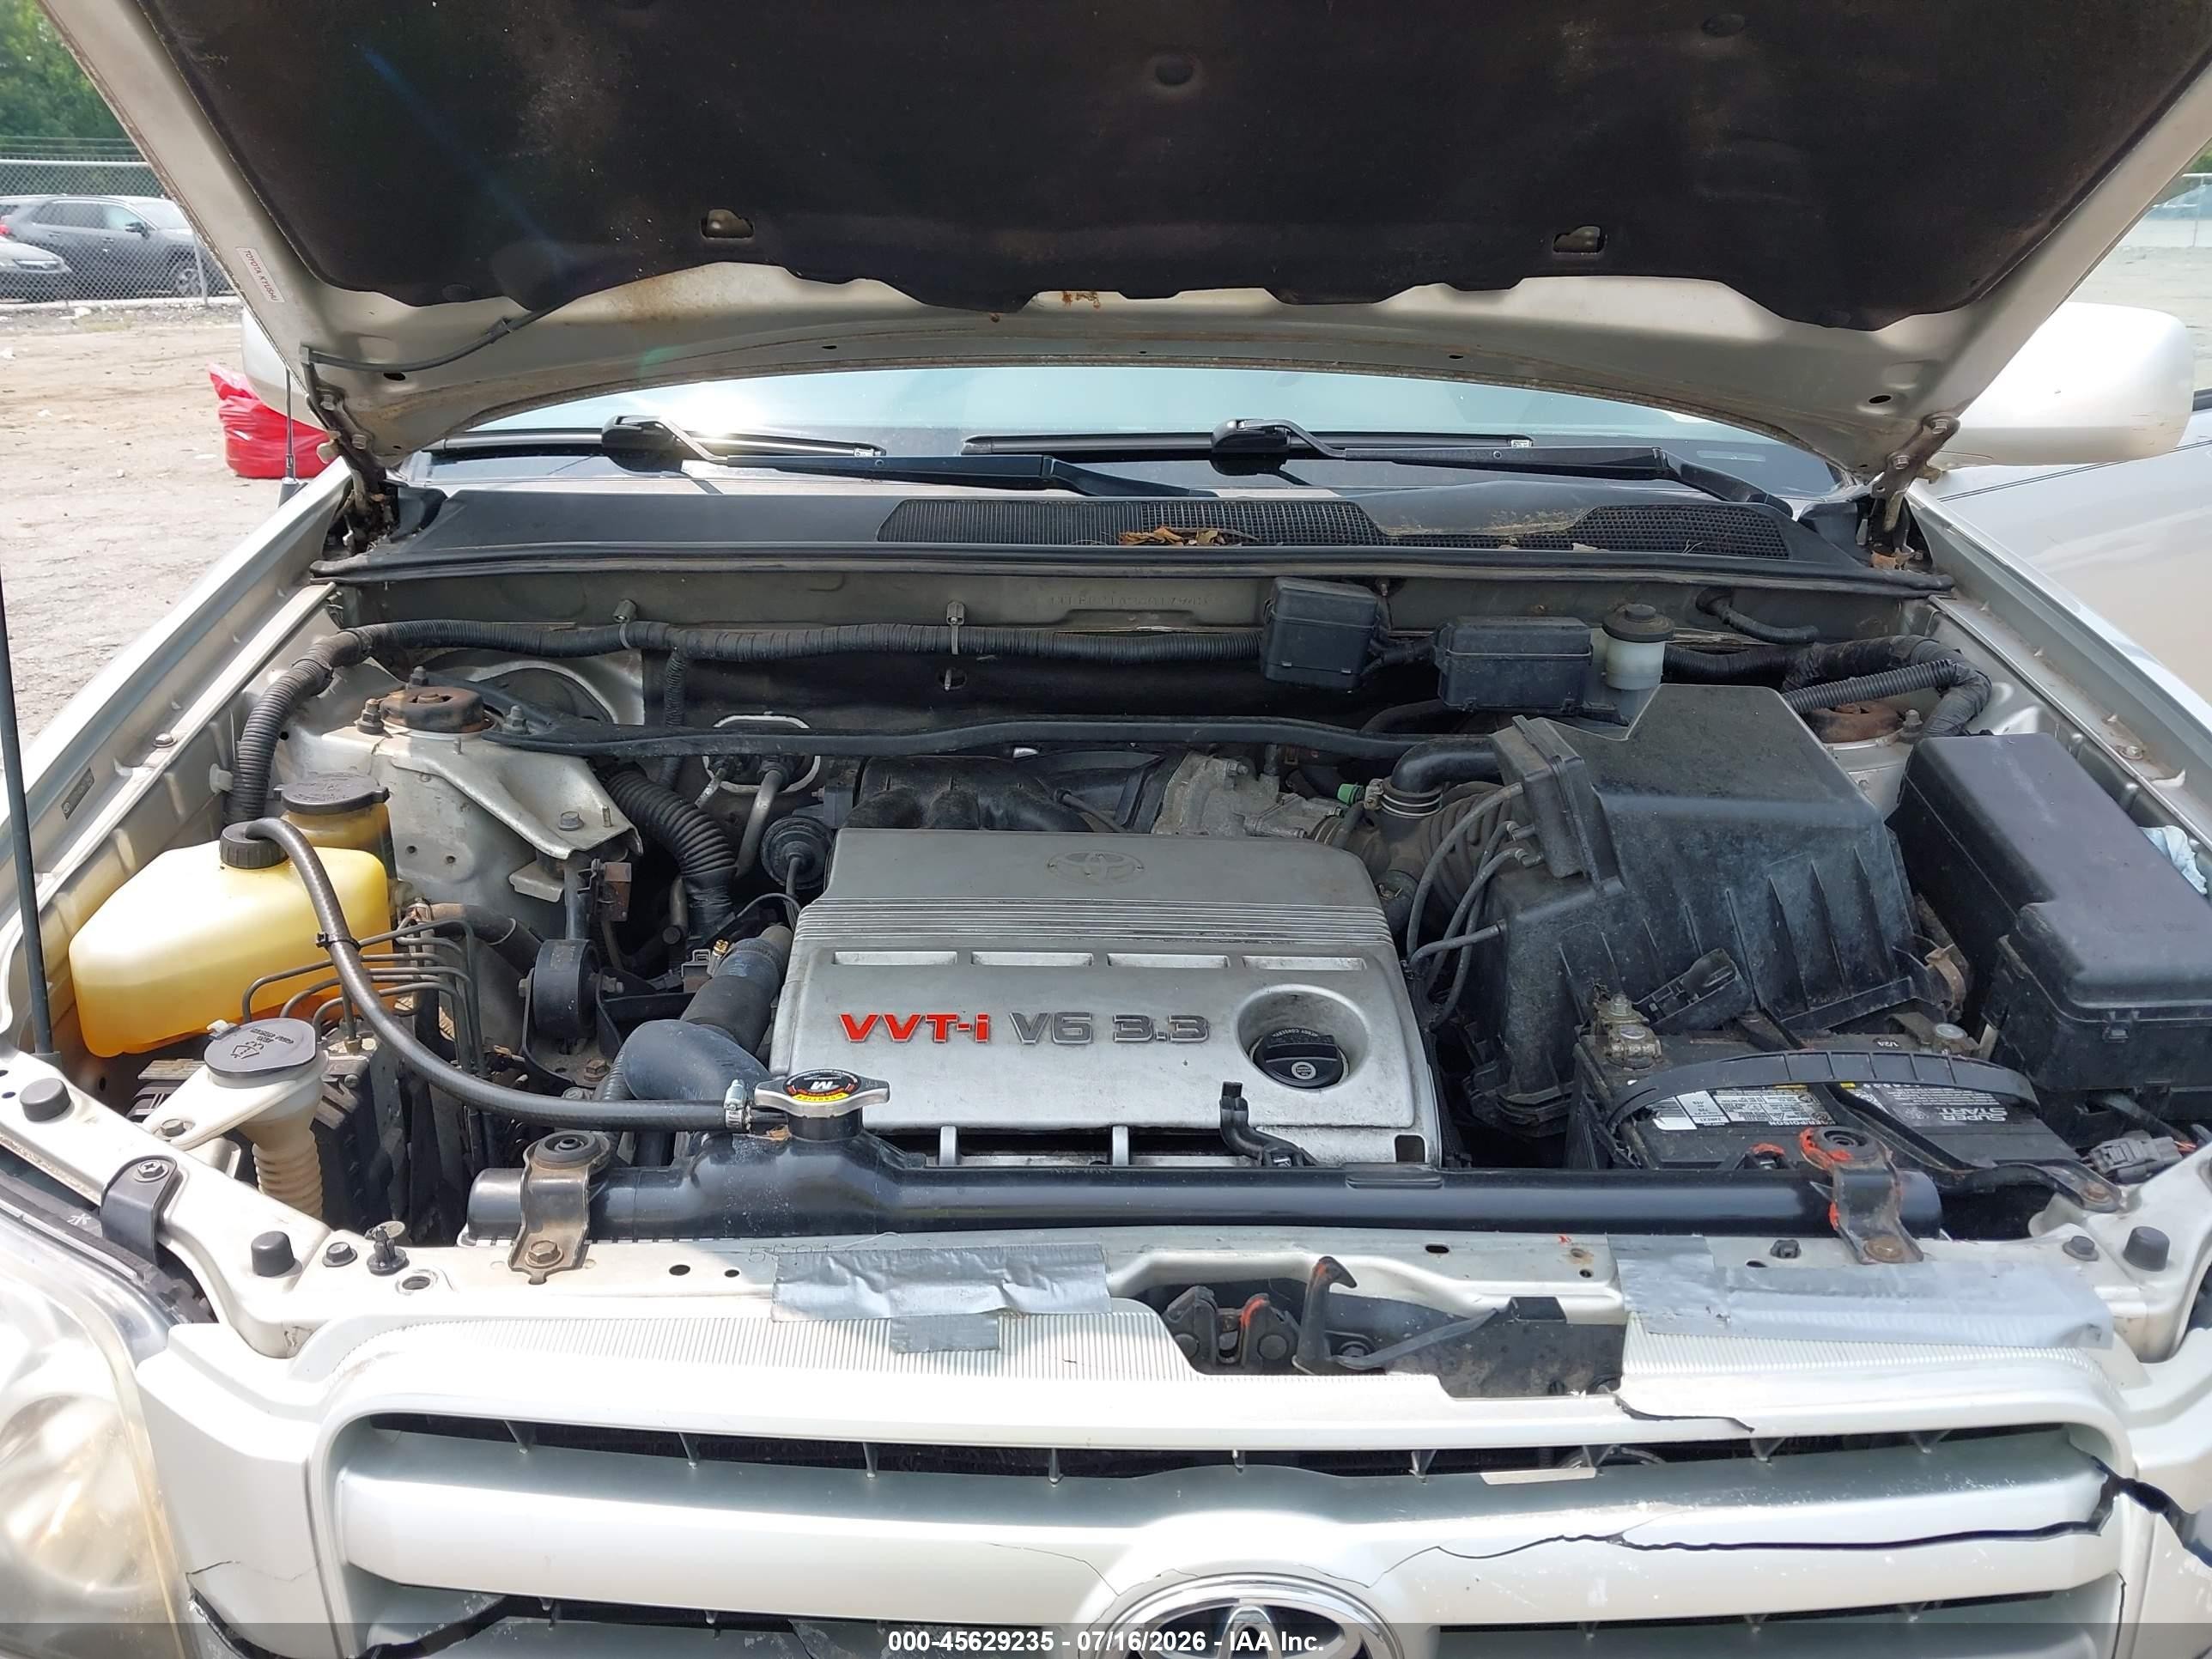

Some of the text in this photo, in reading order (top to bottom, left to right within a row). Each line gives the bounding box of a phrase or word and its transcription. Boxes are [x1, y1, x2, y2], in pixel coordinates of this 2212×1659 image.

[242, 250, 262, 274] TOYOTA
[839, 1012, 1210, 1044] VVT-i V6 3.3
